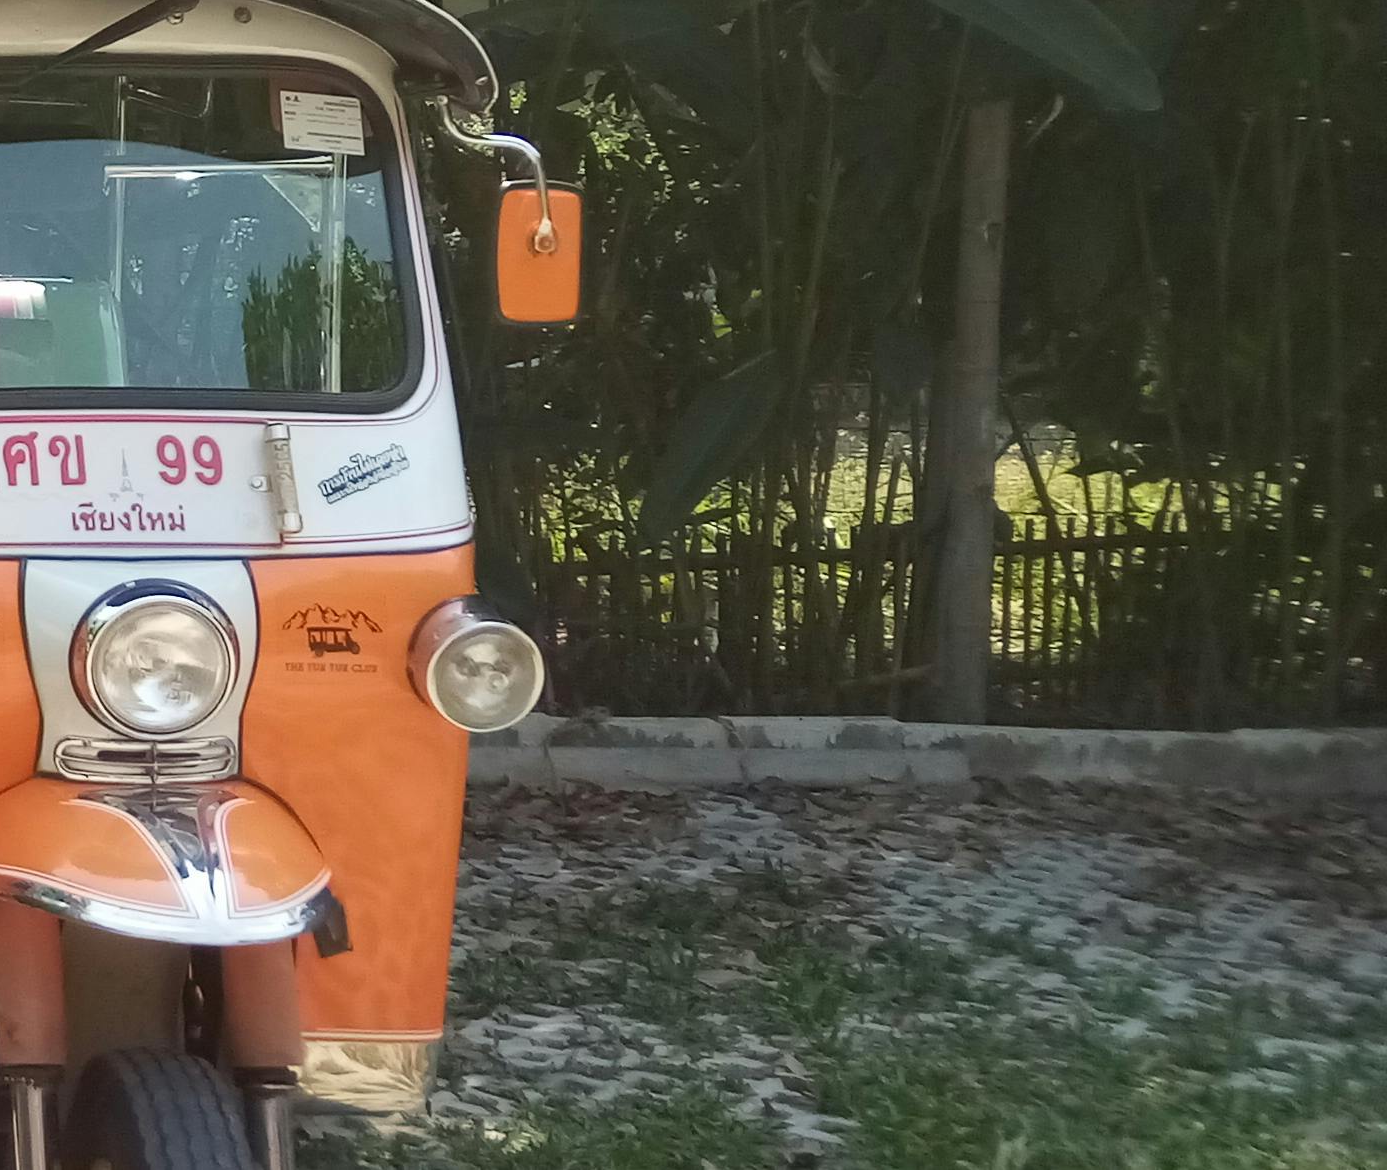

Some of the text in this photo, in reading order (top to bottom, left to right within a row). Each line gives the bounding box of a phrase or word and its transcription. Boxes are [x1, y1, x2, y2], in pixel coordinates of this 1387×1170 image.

[2, 430, 223, 487] ศข 99
[71, 502, 186, 533] เชียงใหม่
